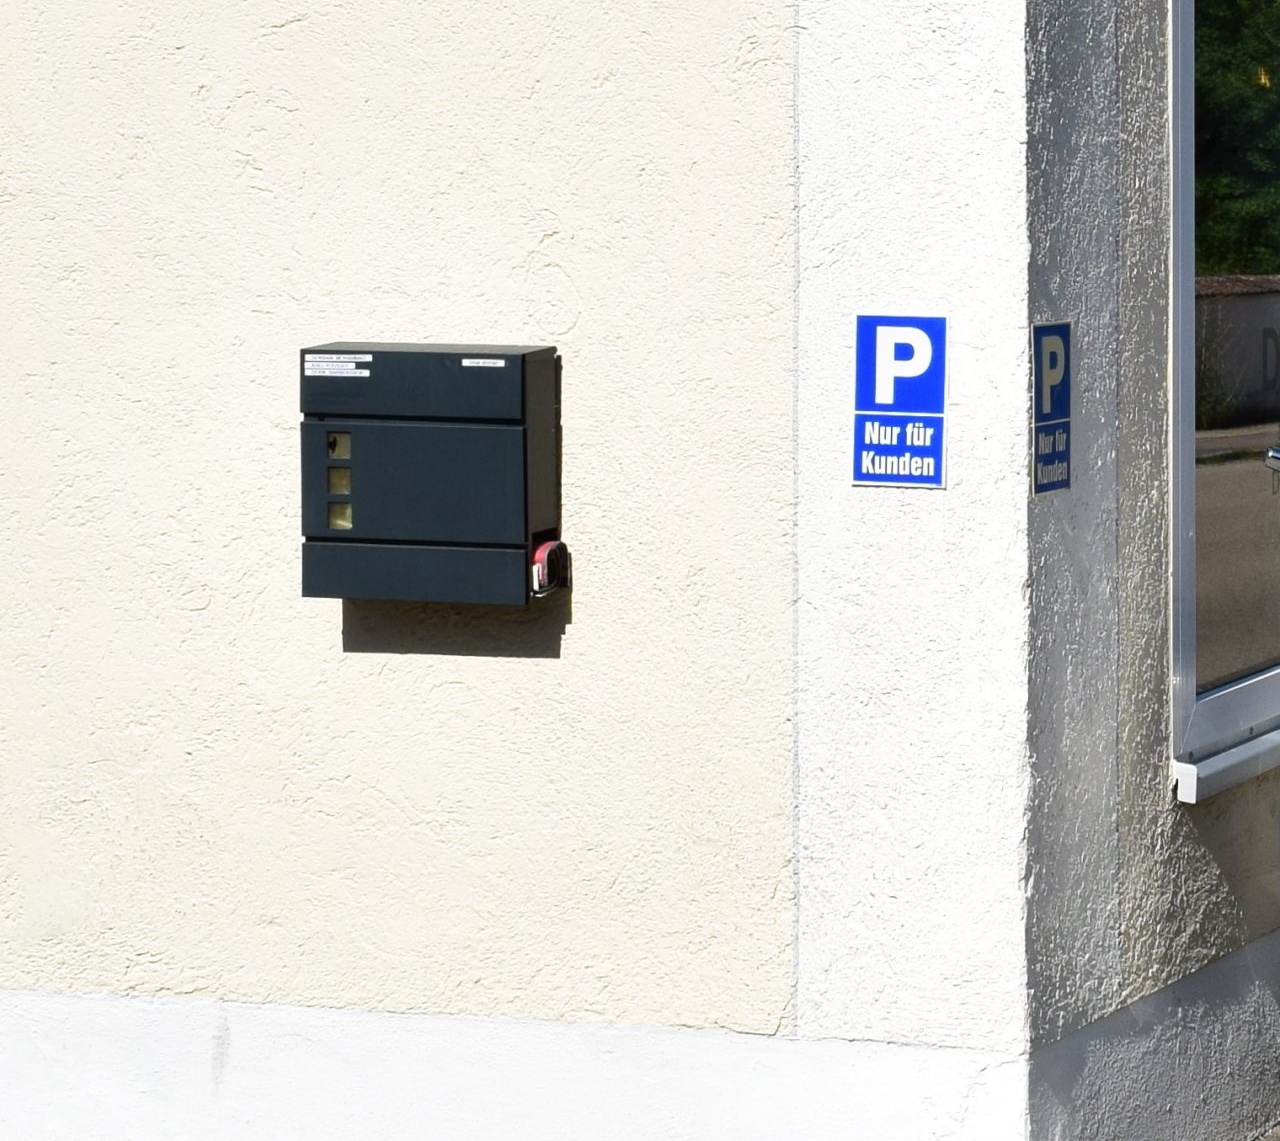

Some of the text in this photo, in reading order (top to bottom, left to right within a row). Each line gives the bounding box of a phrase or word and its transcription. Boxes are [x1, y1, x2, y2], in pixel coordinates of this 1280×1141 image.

[874, 325, 933, 405] P
[1041, 335, 1065, 414] P
[864, 421, 935, 447] Nur für
[1038, 429, 1067, 455] Nur für
[861, 450, 935, 477] Kunden
[1037, 461, 1068, 485] Kunden
